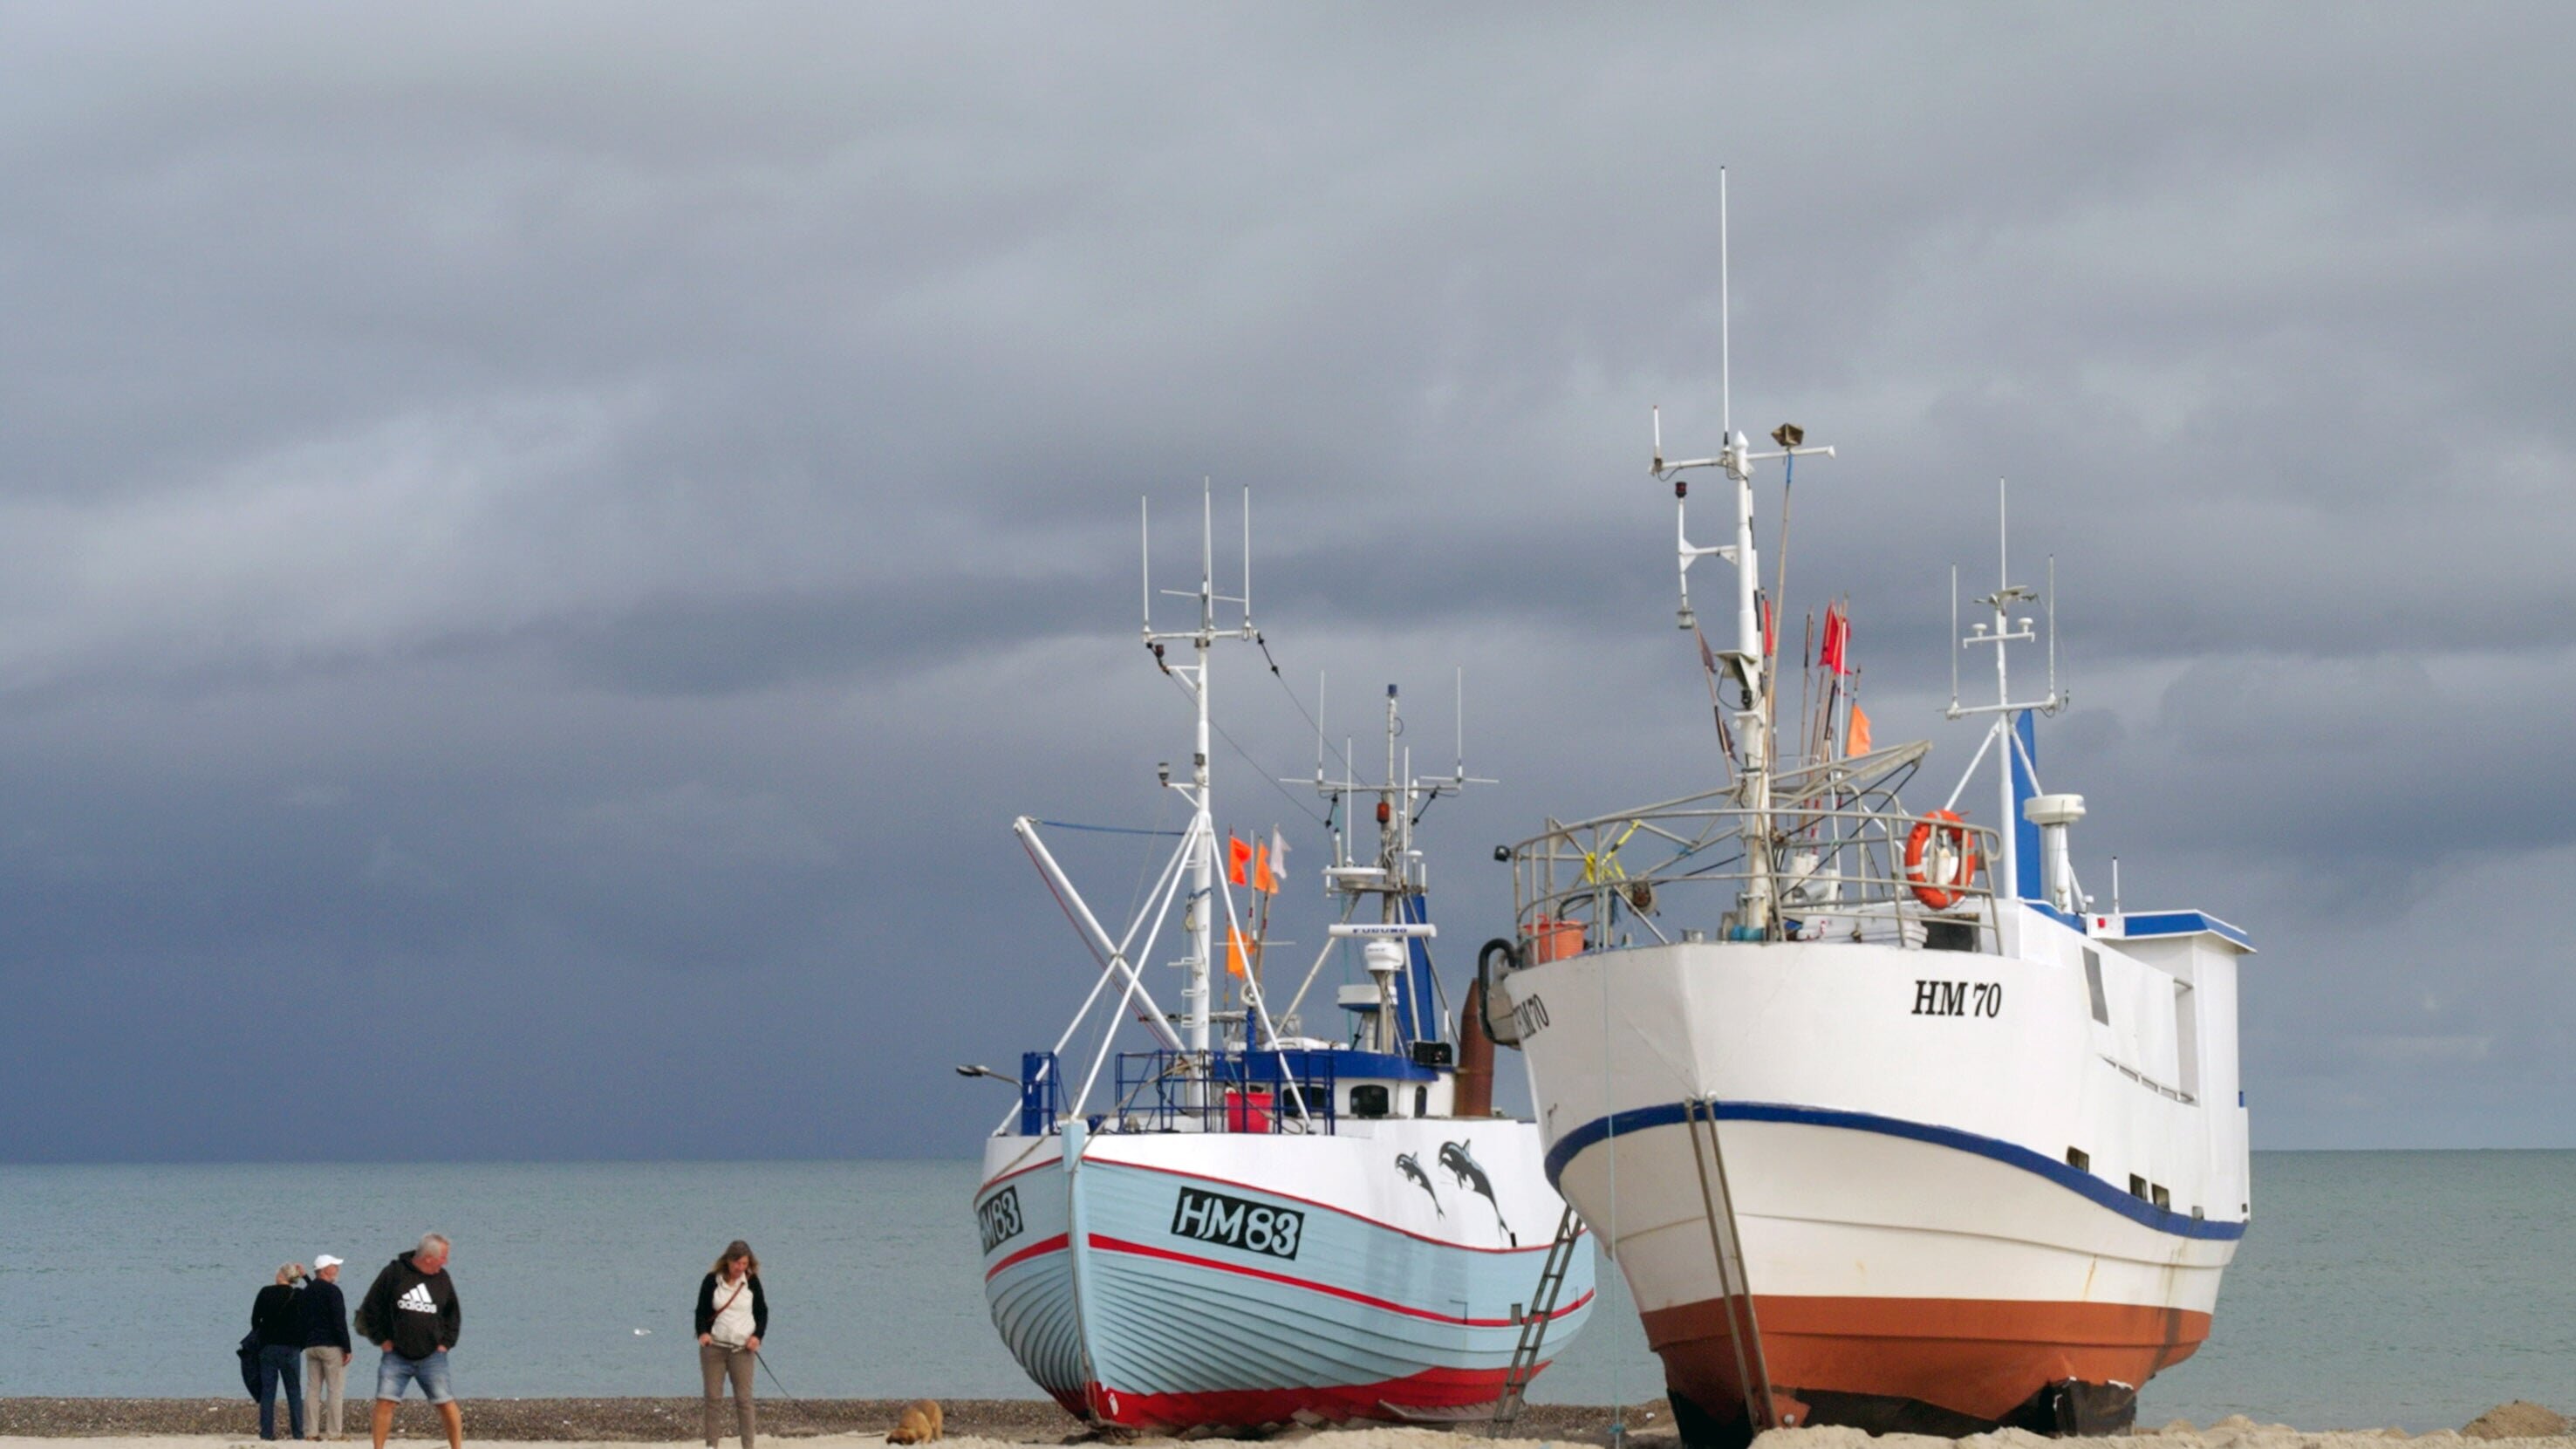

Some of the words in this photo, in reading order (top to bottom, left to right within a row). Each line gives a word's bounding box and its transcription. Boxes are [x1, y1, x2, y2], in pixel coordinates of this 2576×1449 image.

[1911, 980, 1968, 1016] HM
[1972, 982, 2002, 1019] 70
[397, 1299, 437, 1314] adidas
